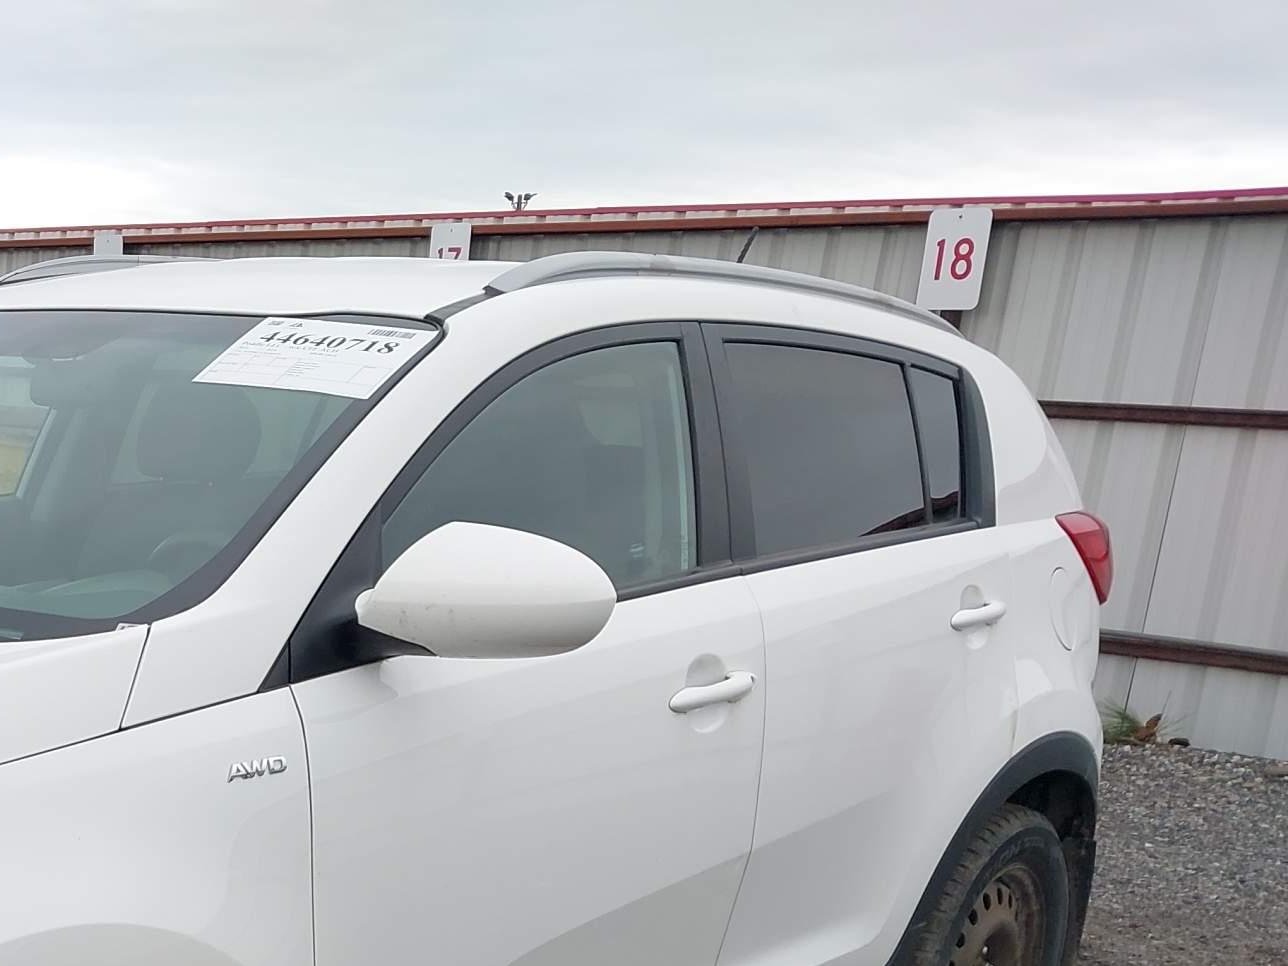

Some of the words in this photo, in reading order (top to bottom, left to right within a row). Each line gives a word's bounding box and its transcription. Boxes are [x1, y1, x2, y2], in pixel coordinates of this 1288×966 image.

[934, 237, 975, 281] 18
[259, 331, 400, 354] 44640718
[227, 755, 288, 783] AWD
